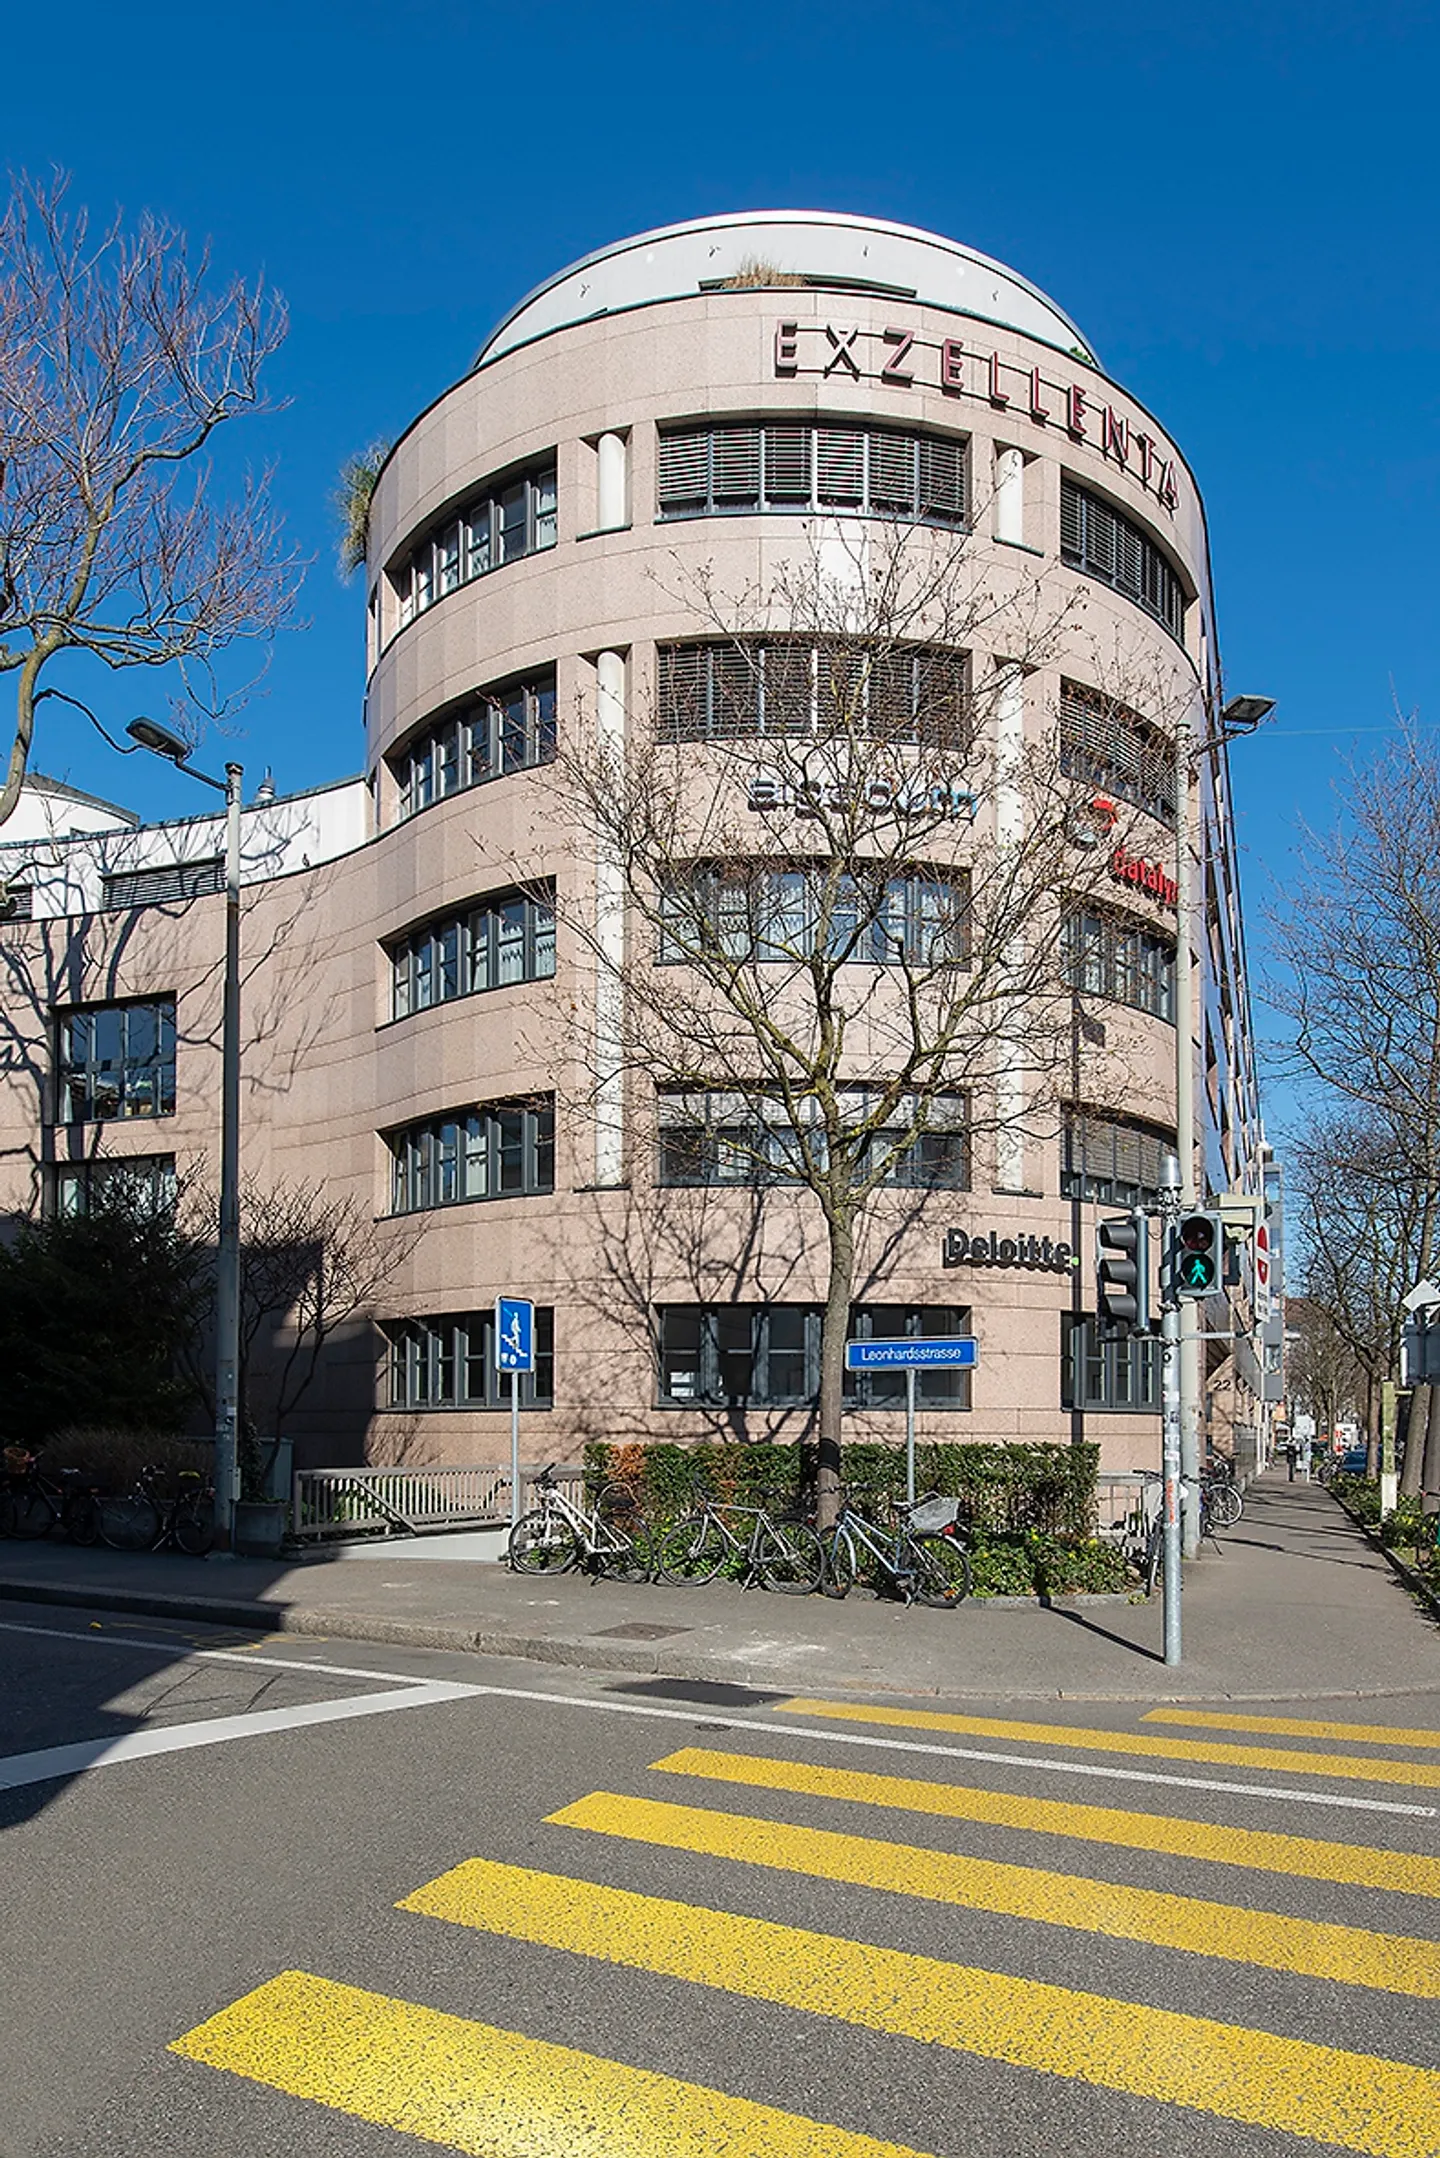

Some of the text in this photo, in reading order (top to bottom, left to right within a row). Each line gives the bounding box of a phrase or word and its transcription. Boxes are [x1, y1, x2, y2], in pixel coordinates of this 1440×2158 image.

[775, 319, 1178, 510] EXZELLENTA
[861, 1346, 961, 1361] Leonhardsstrasse
[1213, 1379, 1231, 1391] 22
